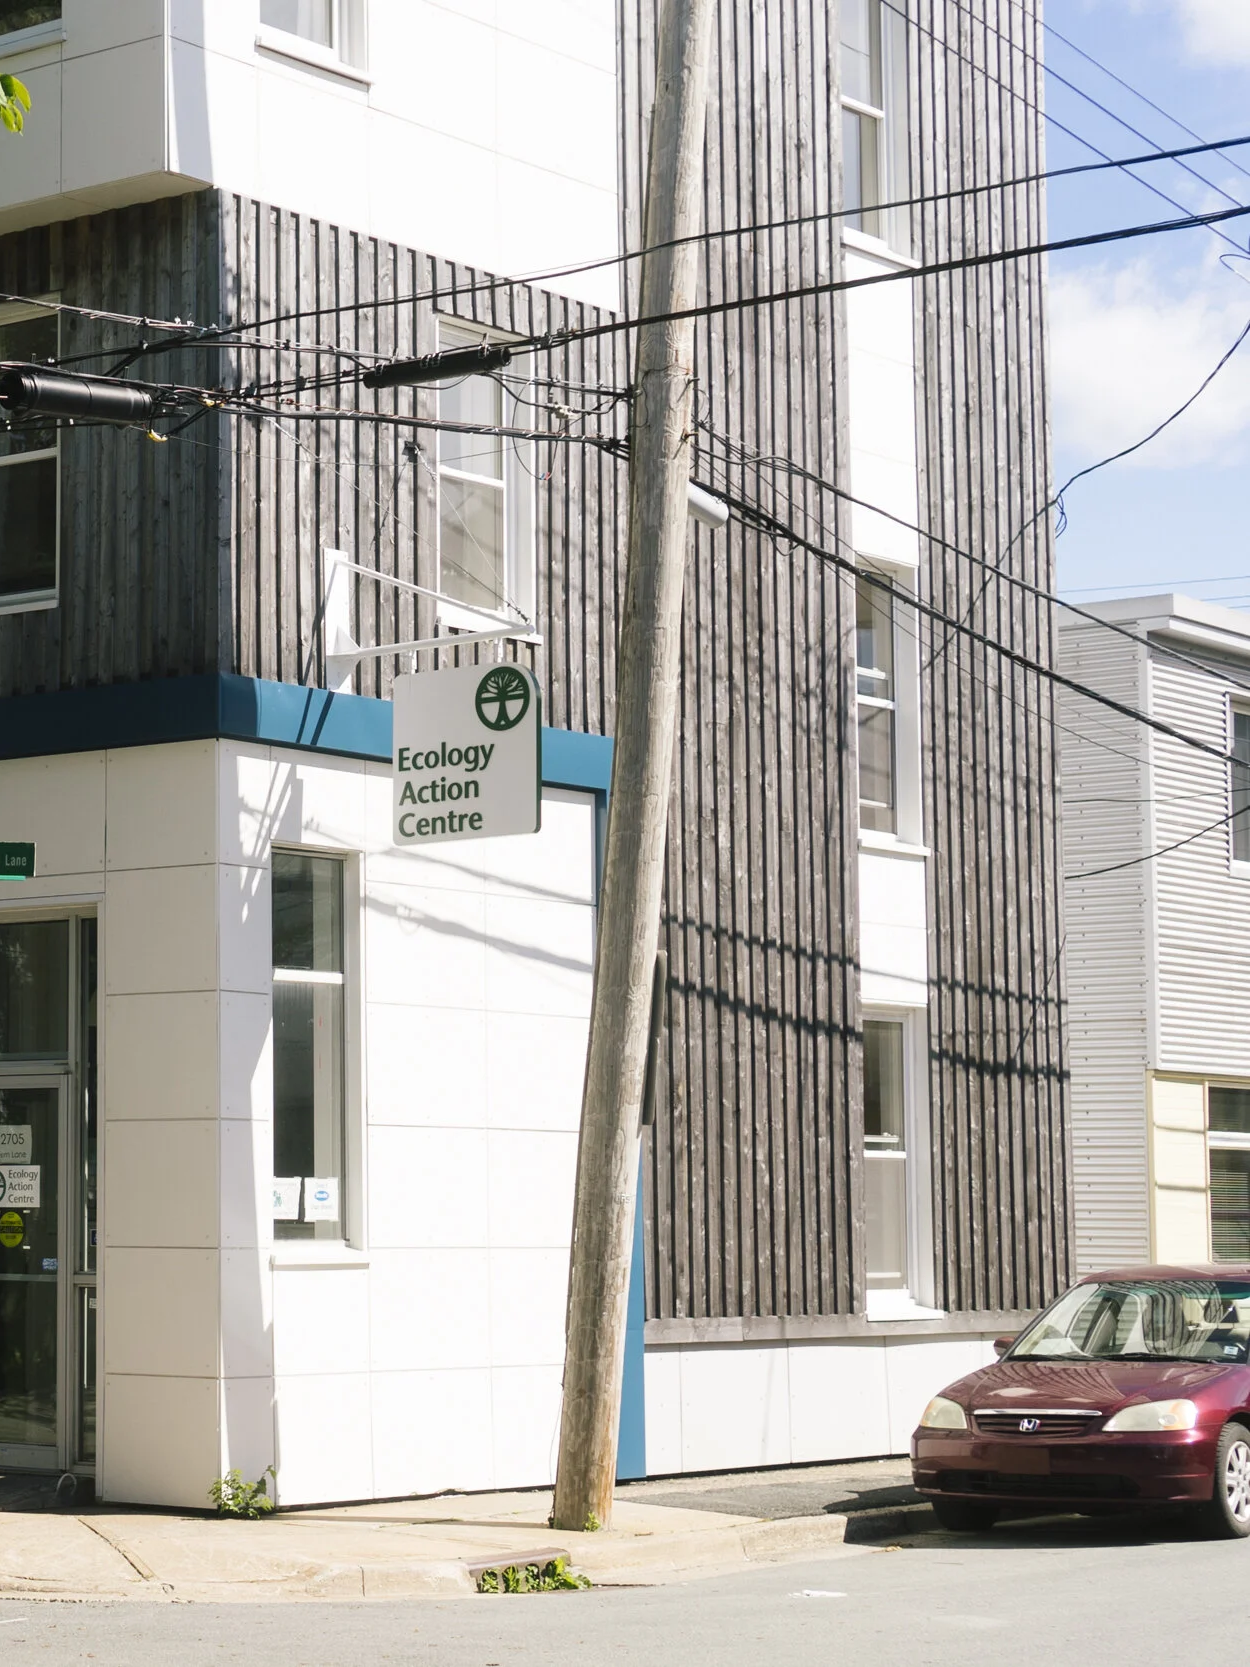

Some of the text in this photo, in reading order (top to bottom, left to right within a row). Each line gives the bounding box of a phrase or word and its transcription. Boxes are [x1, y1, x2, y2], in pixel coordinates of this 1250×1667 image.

[398, 742, 495, 772] Ecology
[399, 776, 480, 806] Action
[398, 810, 483, 838] Centre
[5, 854, 27, 866] Lane
[0, 1133, 25, 1145] 2705
[8, 1169, 38, 1181] Ecology
[7, 1182, 33, 1191] Action
[8, 1194, 35, 1204] Centre
